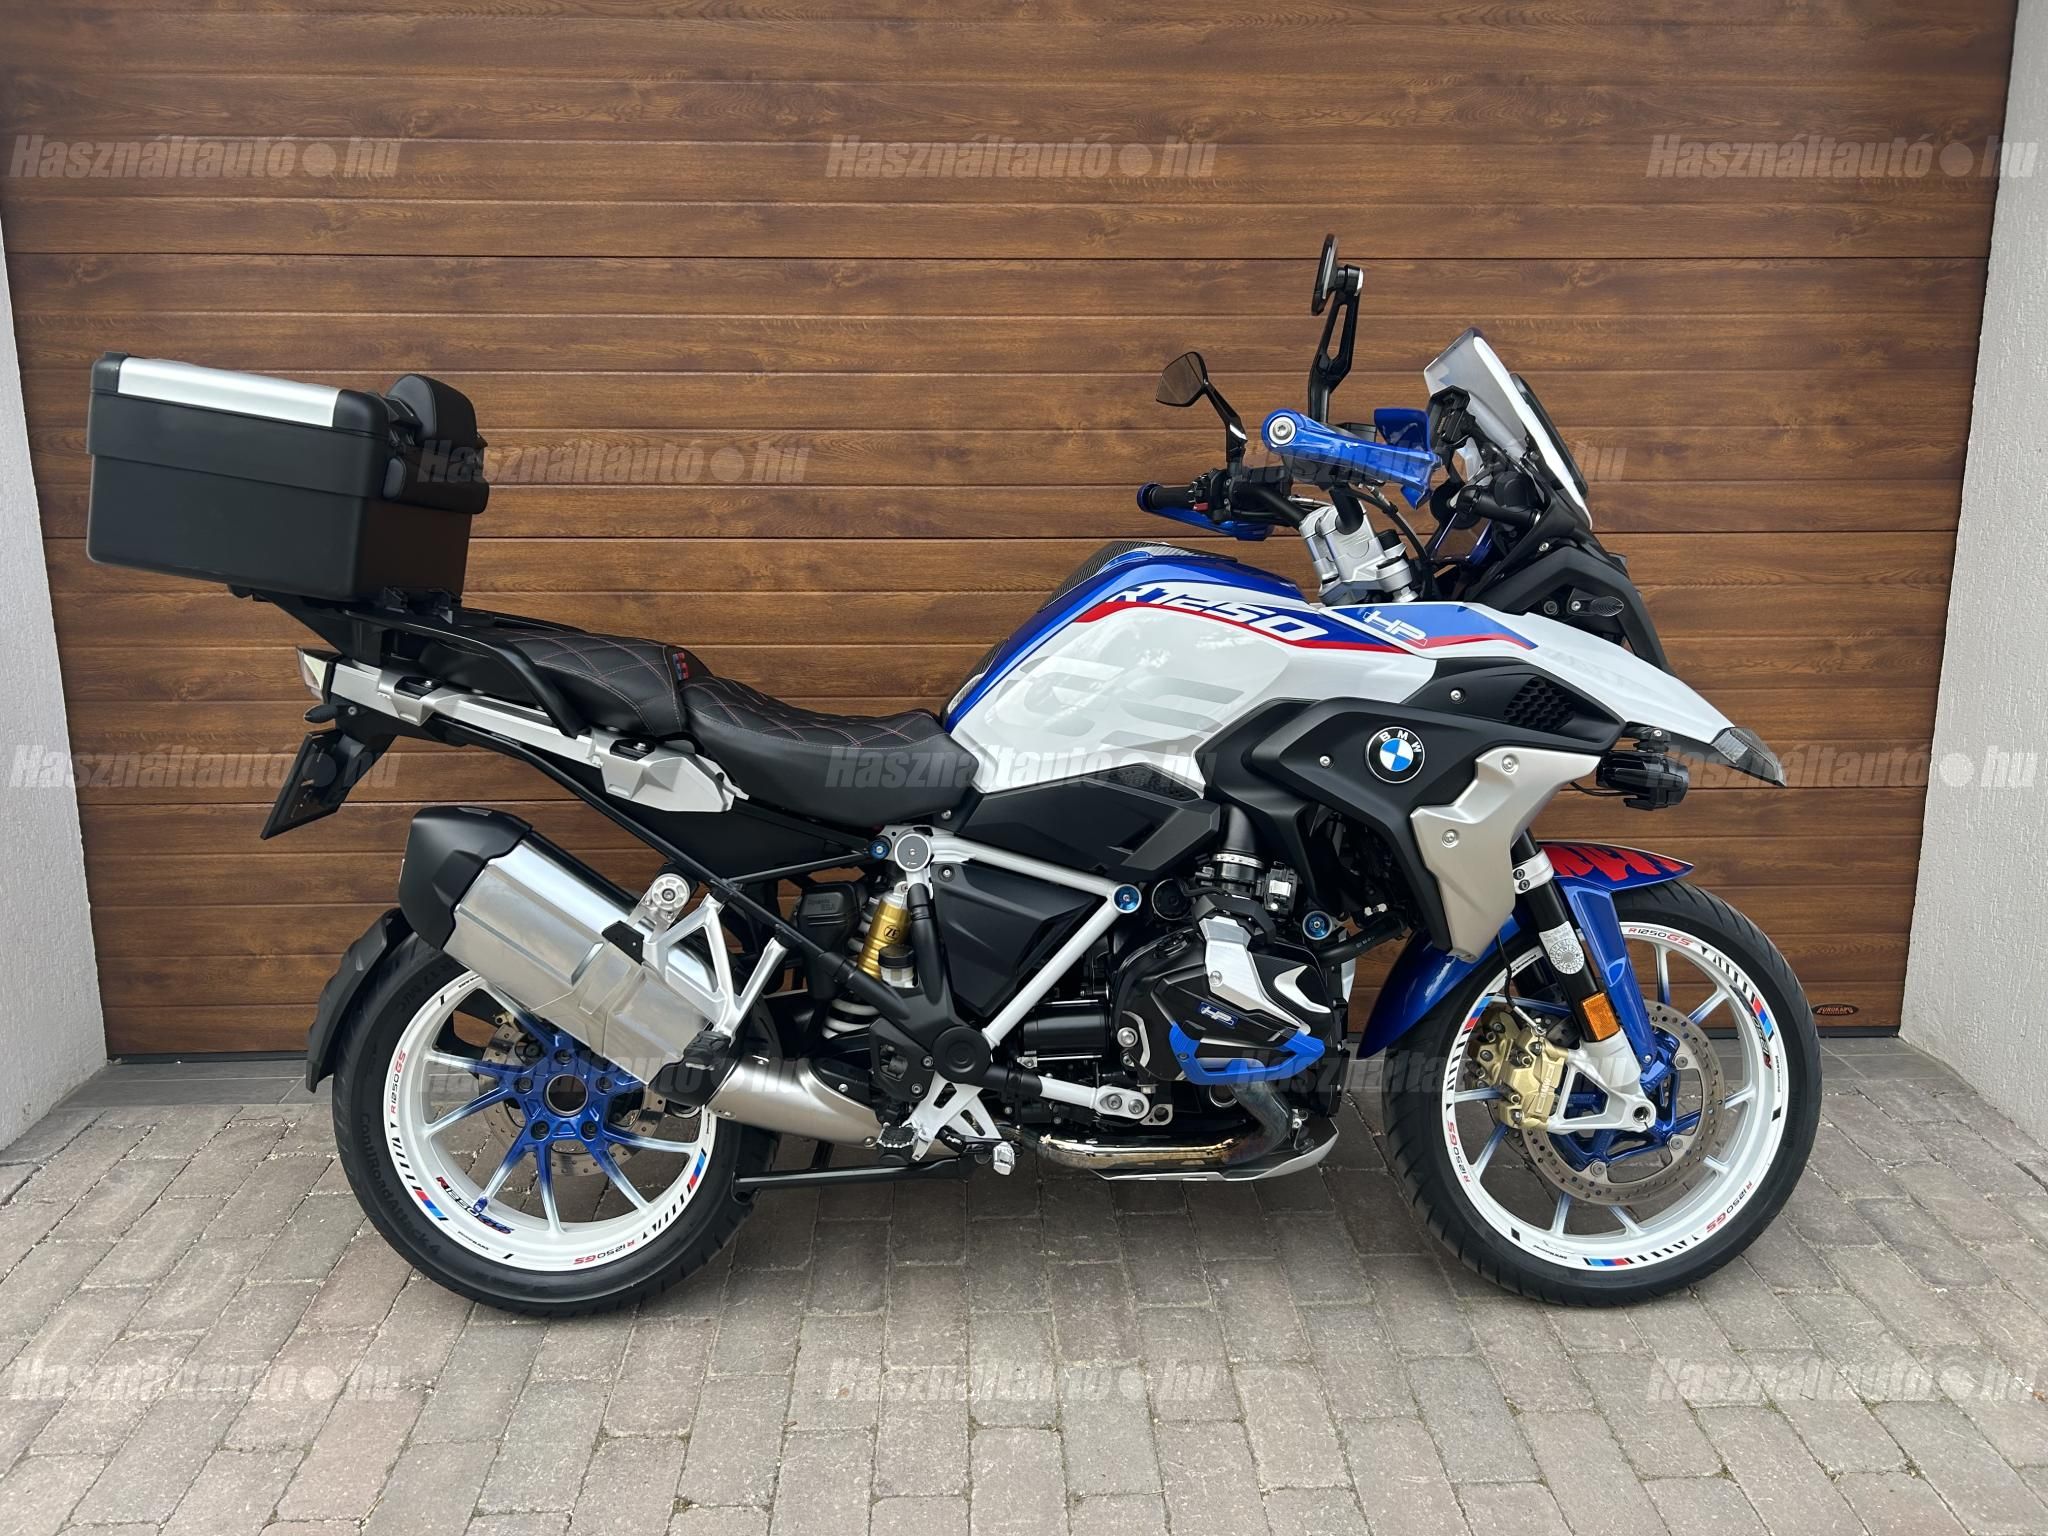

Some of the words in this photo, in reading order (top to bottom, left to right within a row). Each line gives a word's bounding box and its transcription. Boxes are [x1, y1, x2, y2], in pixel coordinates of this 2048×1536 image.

[1363, 610, 1428, 646] HP
[1379, 729, 1422, 753] BMW
[884, 928, 898, 938] ZF
